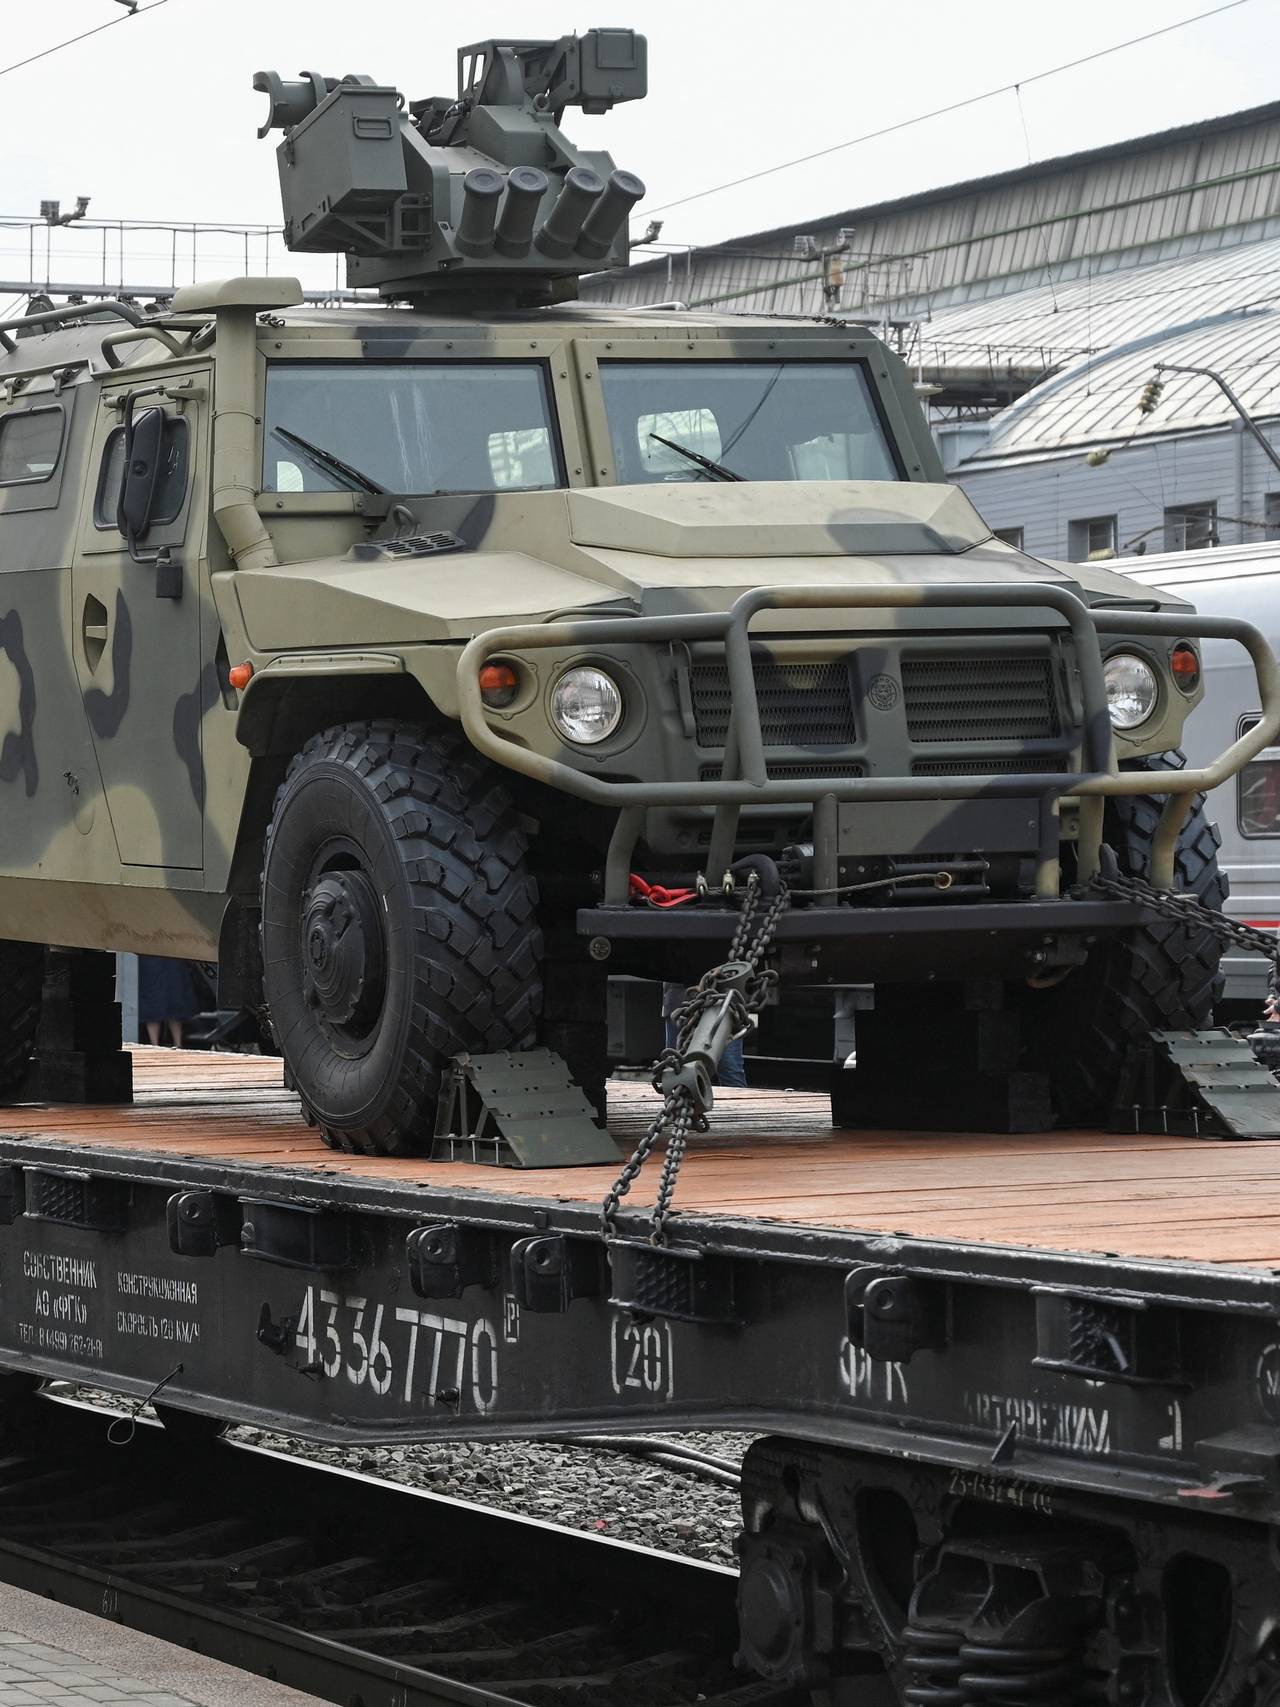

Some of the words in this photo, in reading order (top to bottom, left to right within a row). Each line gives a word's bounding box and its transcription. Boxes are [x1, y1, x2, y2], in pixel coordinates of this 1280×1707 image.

[23, 1250, 97, 1289] СОБСТВЕННИК
[35, 1288, 50, 1317] АО
[117, 1271, 198, 1305] КОНСТРУКЦИОННАЯ
[117, 1311, 158, 1338] СКОРОСТЬ
[295, 1285, 497, 1416] 43367770
